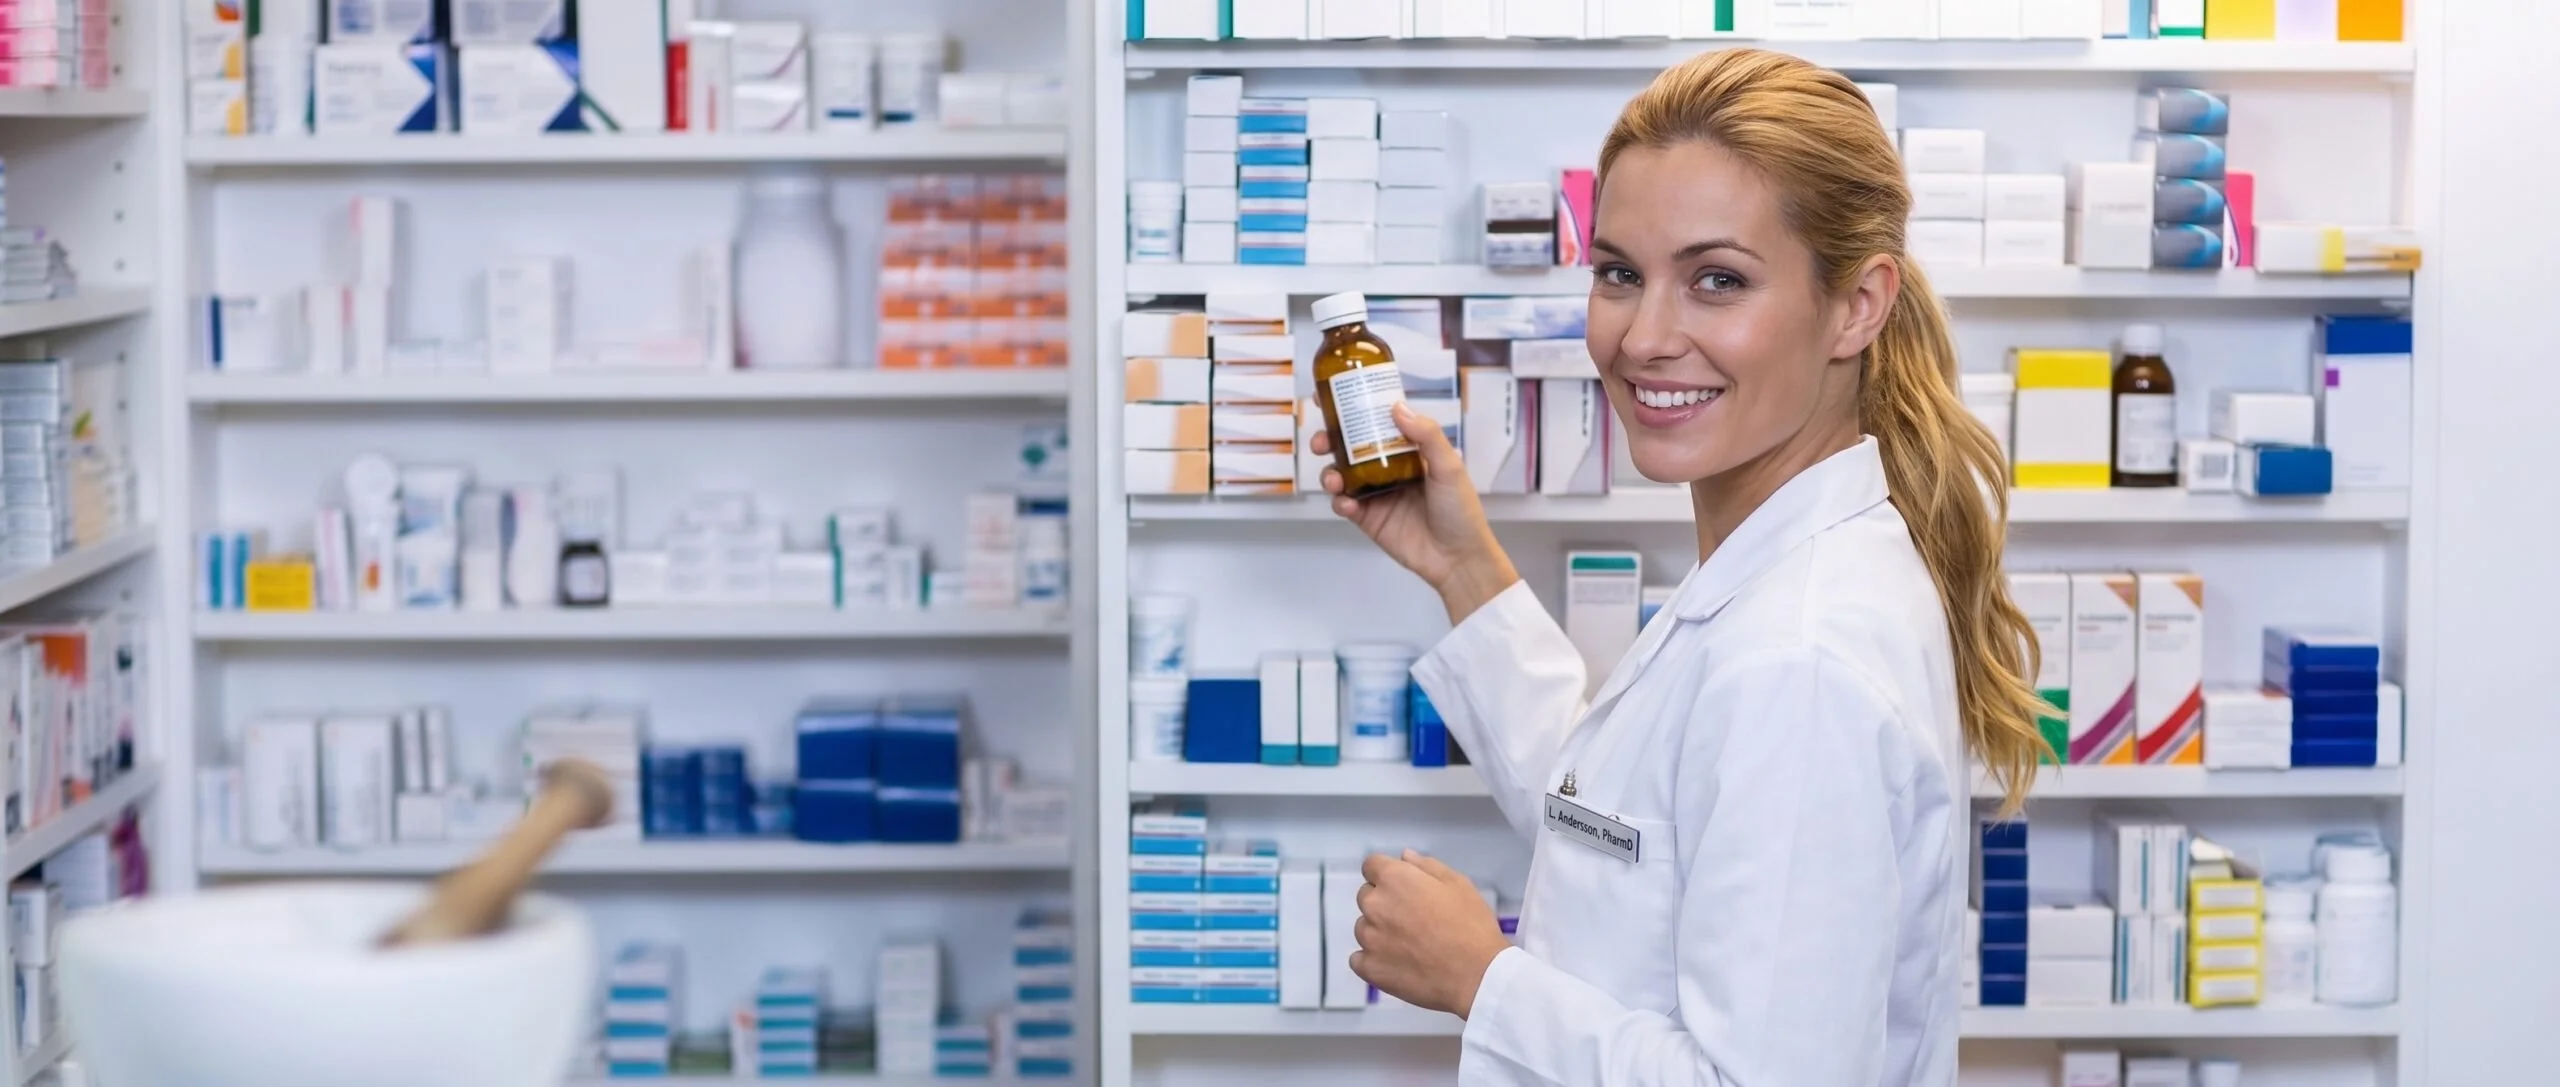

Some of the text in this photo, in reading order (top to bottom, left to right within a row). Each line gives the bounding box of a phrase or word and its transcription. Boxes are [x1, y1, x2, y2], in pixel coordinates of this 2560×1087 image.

[1548, 805, 1633, 851] L. Andersson, PharmD
